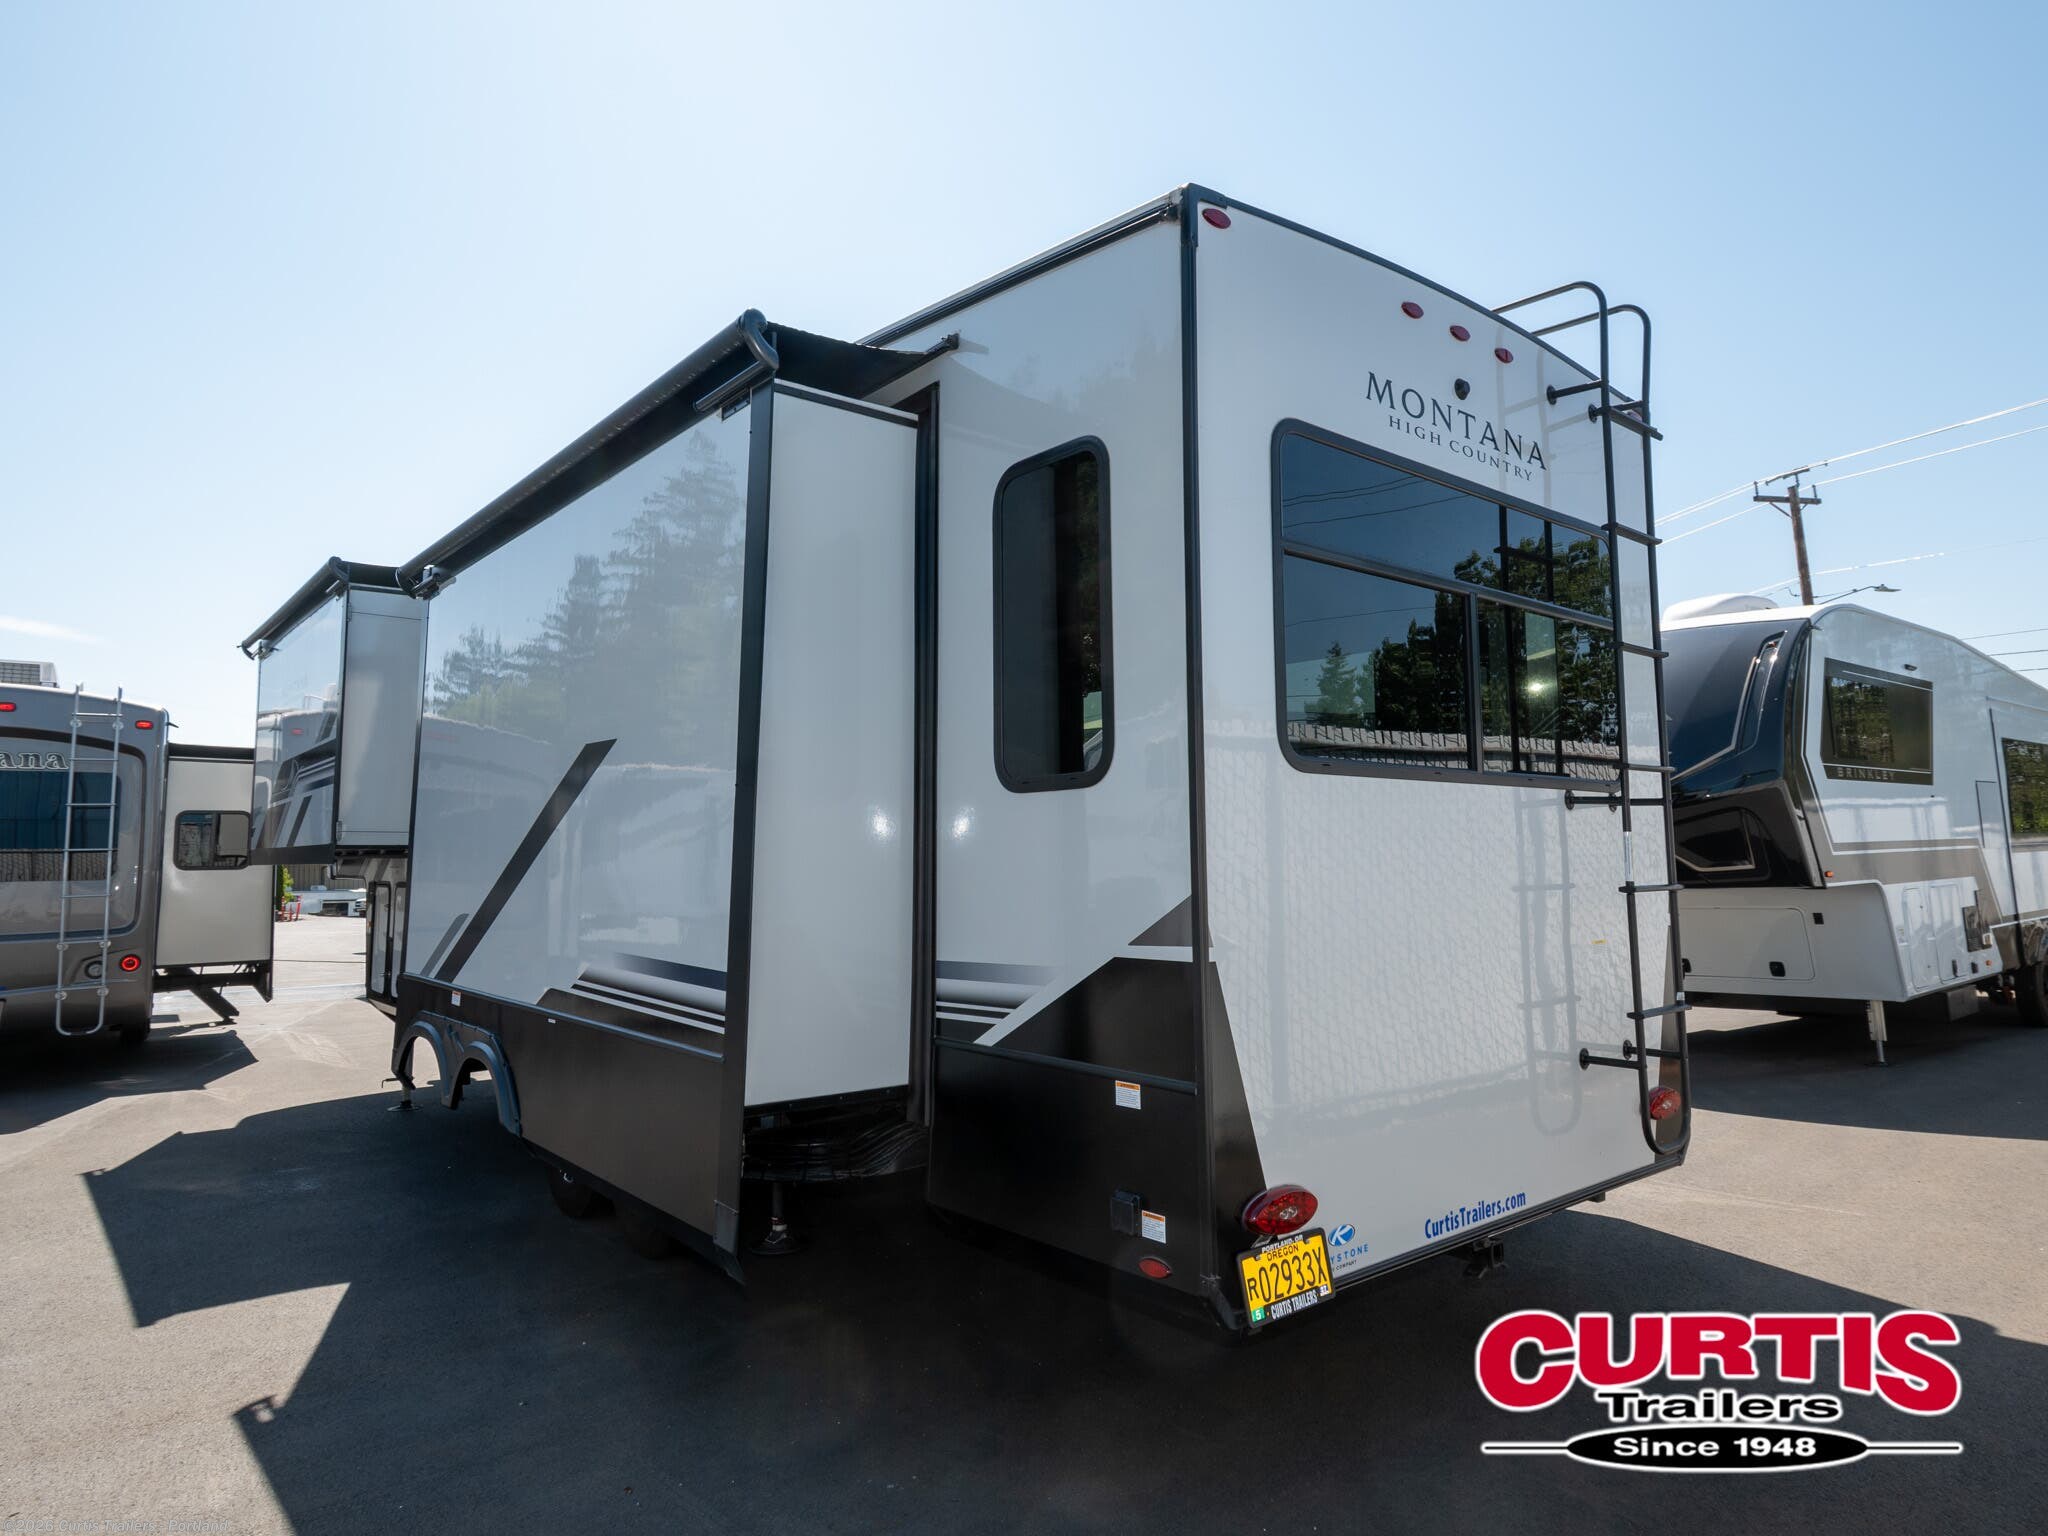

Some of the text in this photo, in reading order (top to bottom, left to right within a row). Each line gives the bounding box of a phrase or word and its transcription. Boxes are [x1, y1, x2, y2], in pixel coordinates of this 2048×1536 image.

[1366, 371, 1547, 470] MONTANA
[1388, 415, 1533, 481] HIGH COUNTRY
[1837, 767, 1895, 780] BRINKLEY
[1424, 1191, 1526, 1239] CurtisTrailers.com
[1266, 1244, 1299, 1261] OREGON
[1330, 1244, 1369, 1264] YSTONE
[1247, 1247, 1328, 1303] R02933X
[1255, 1309, 1262, 1320] 5
[1270, 1289, 1318, 1320] CURTIS TRAILERS
